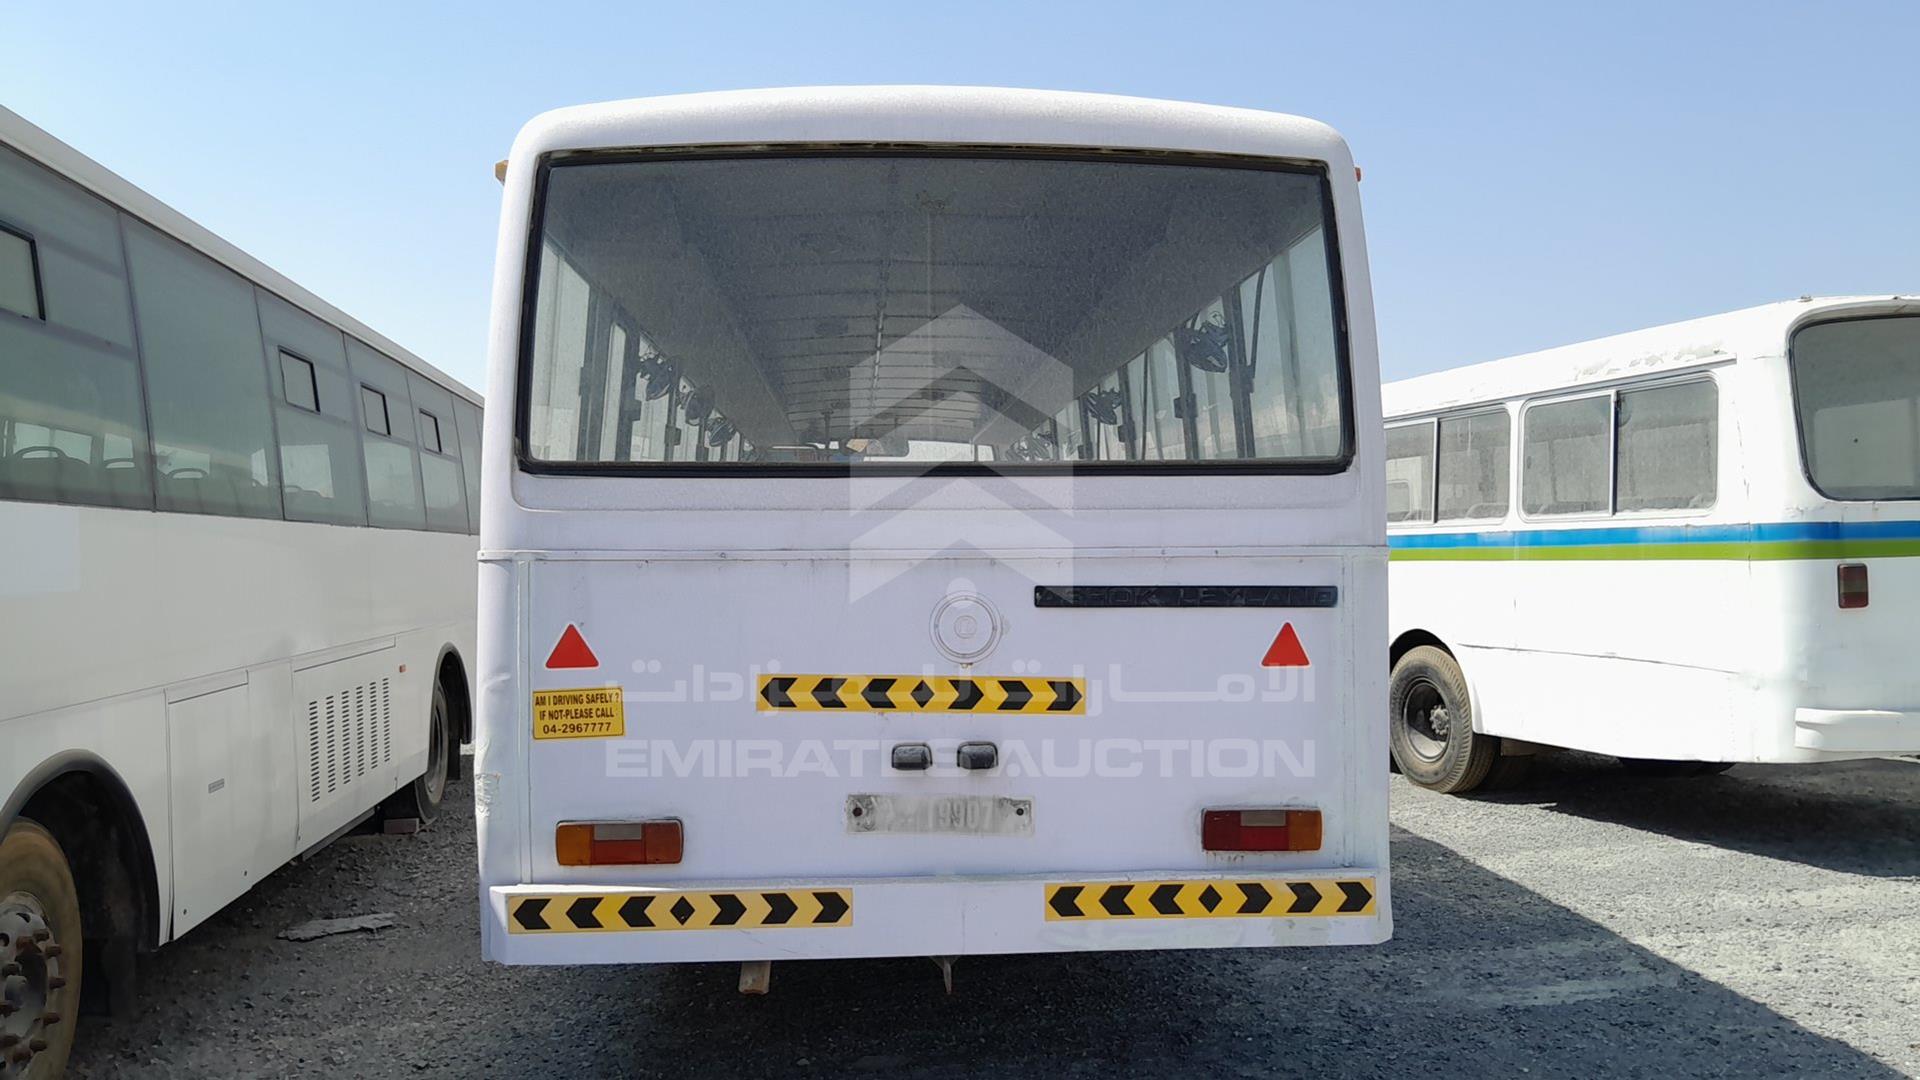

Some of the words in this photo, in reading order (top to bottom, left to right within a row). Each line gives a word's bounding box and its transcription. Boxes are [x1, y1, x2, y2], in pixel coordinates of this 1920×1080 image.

[535, 695, 546, 706] AM
[553, 694, 584, 706] DRIVING
[585, 692, 613, 704] SAFELY
[539, 710, 546, 720] IF
[548, 708, 594, 720] NOT-PLEASE
[595, 707, 614, 718] CALL
[542, 722, 611, 734] 04-2967777
